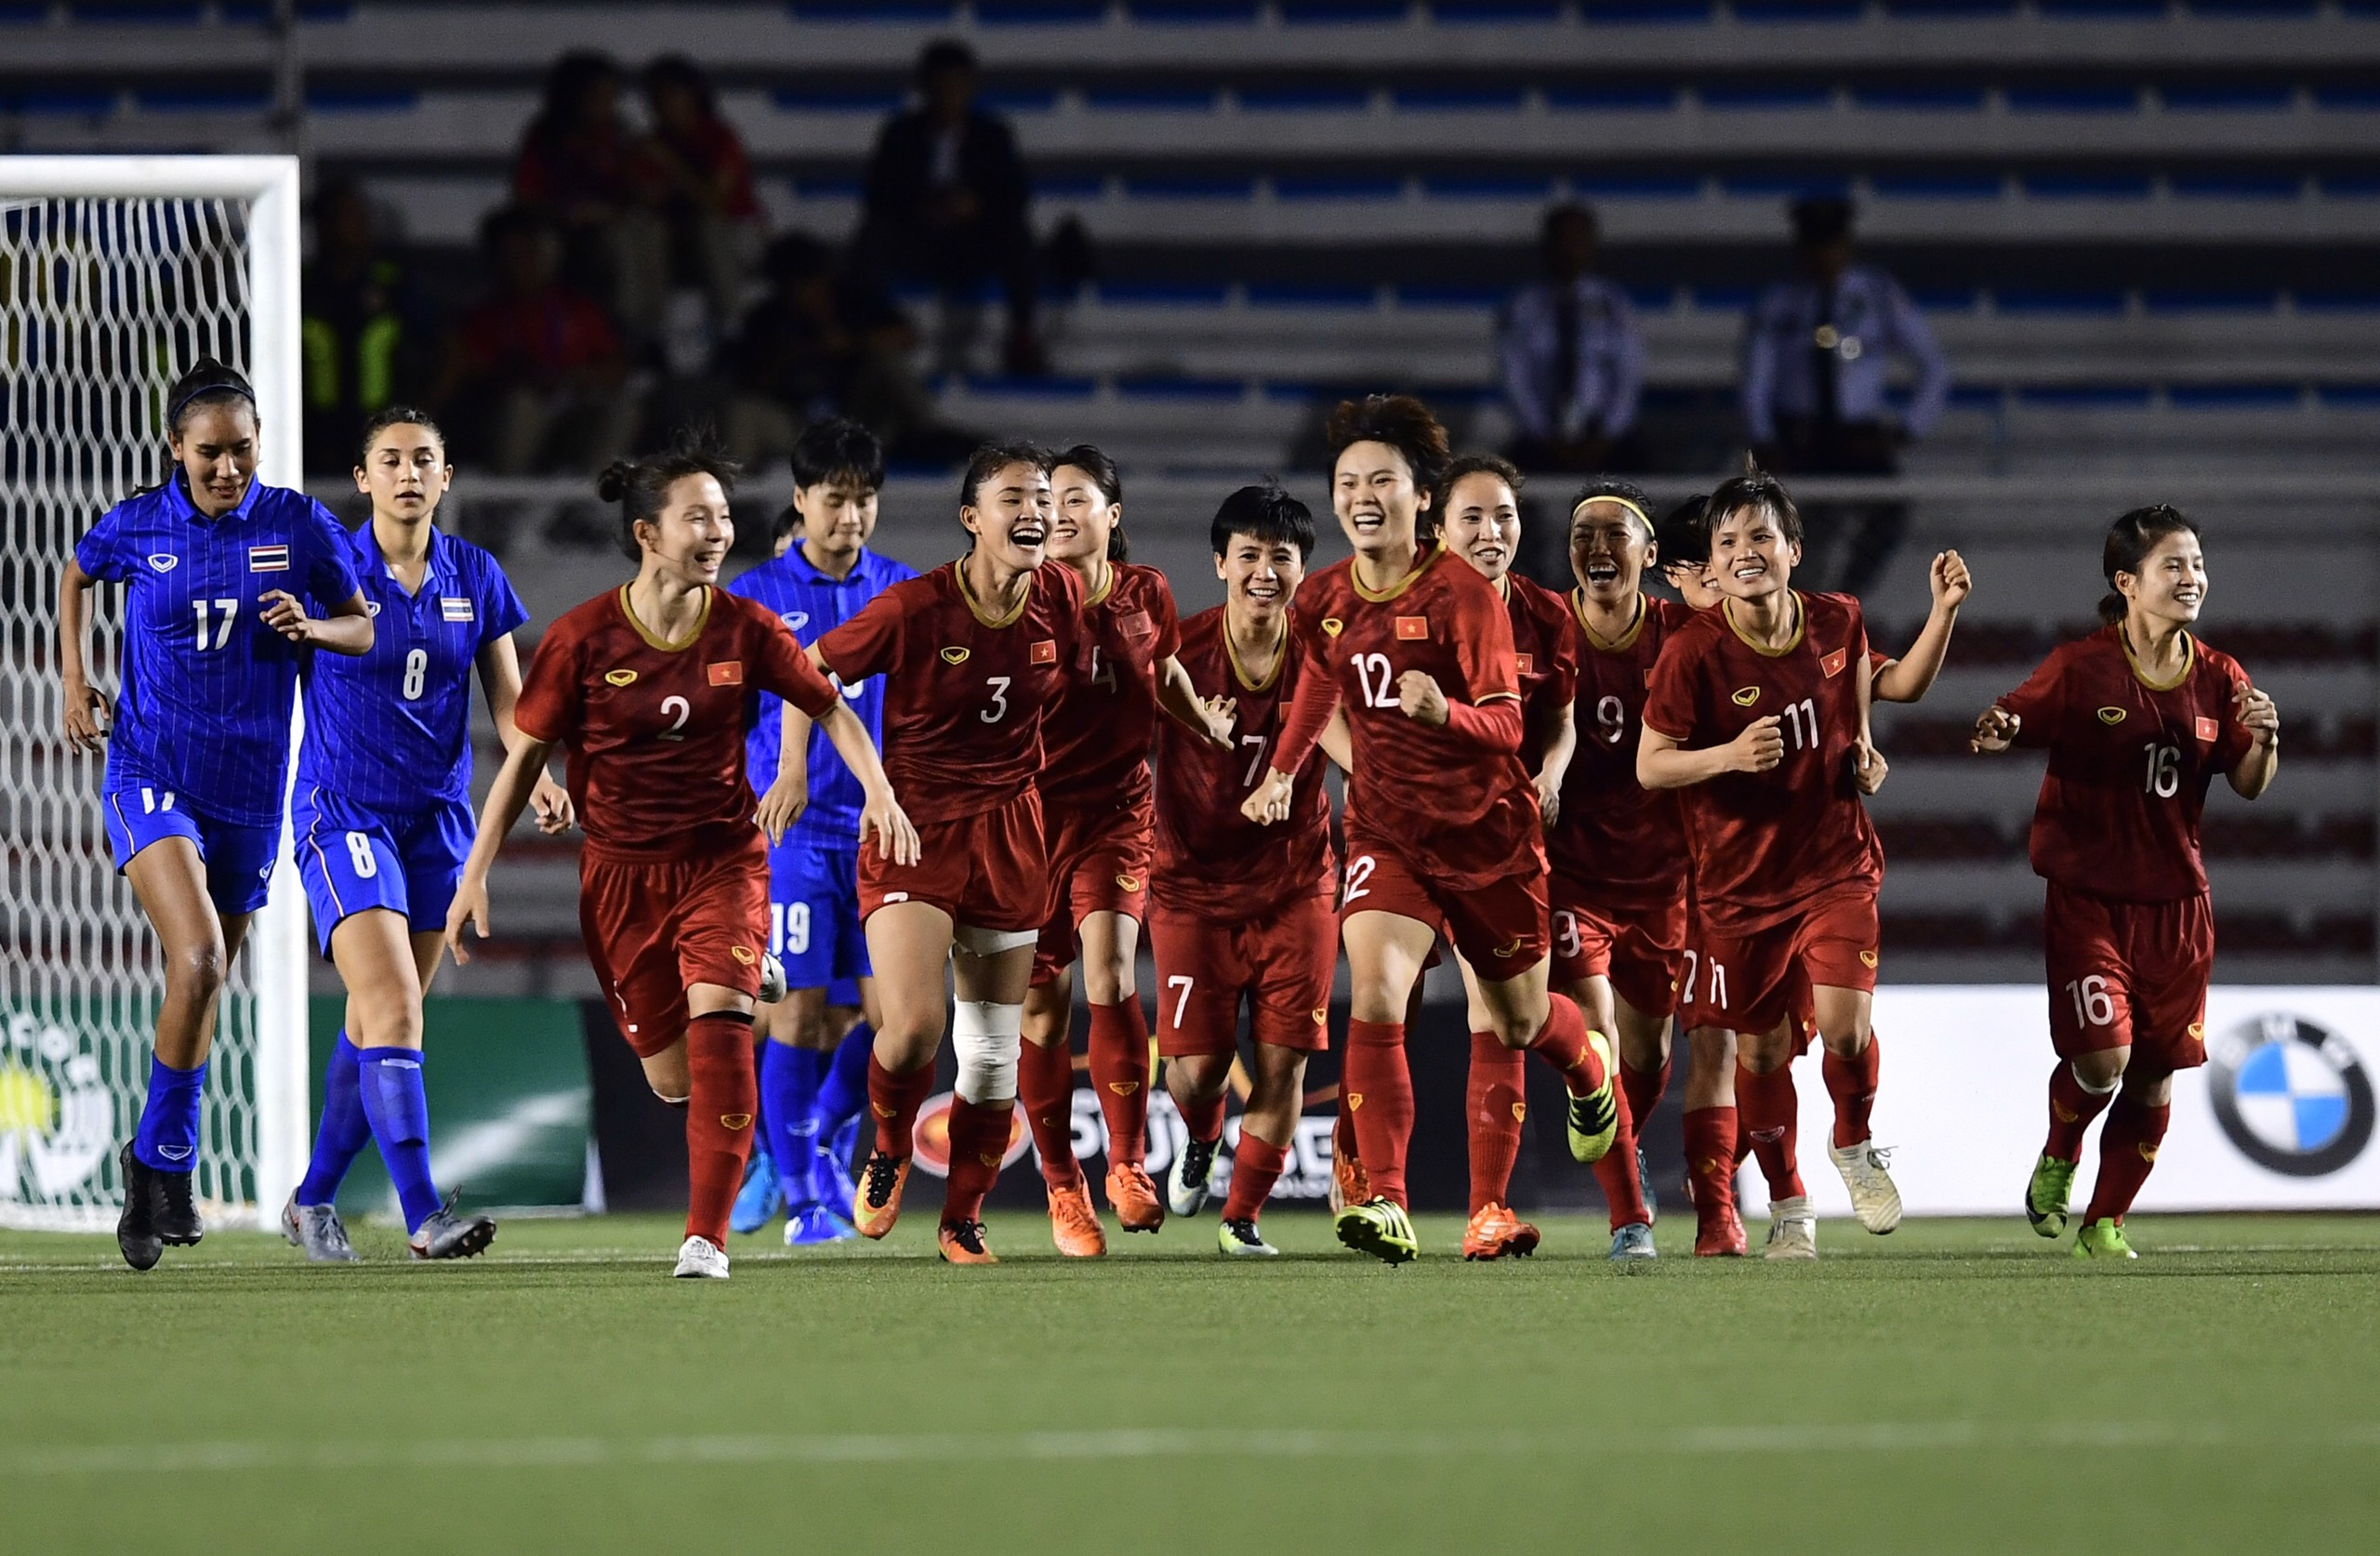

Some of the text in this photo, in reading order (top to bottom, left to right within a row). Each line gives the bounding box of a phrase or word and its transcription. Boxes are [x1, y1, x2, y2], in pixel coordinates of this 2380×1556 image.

[192, 599, 238, 652] 17
[403, 648, 428, 700] 8
[980, 676, 1011, 723] 3
[1351, 653, 1401, 708] 12
[660, 695, 690, 742] 2
[1596, 695, 1624, 744] 9
[1784, 698, 1819, 750] 11
[1241, 734, 1267, 787] 7
[2144, 742, 2182, 798] 16
[345, 831, 377, 878] 8
[770, 902, 811, 956] 19
[1551, 910, 1581, 958] 9
[1168, 974, 1195, 1029] 7
[1709, 956, 1728, 1010] 11
[2066, 974, 2116, 1028] 16
